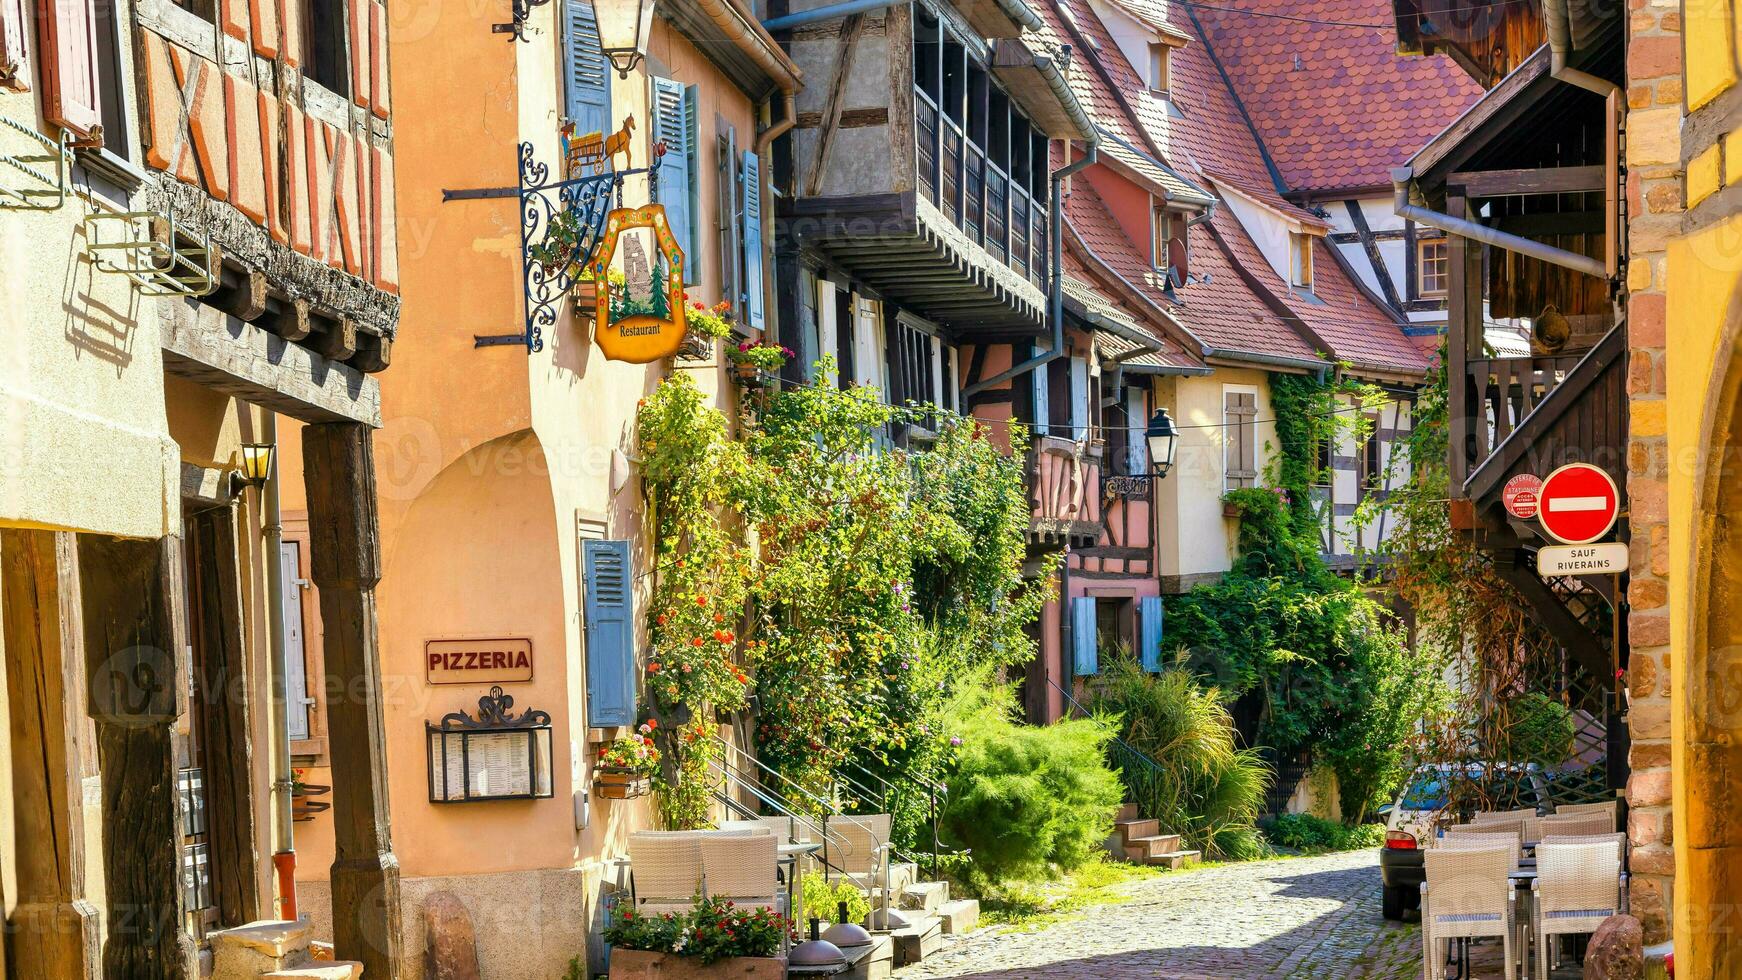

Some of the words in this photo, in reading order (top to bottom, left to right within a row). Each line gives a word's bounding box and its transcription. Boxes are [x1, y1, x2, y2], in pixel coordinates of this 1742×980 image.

[620, 324, 661, 337] Restaurant
[1571, 549, 1596, 557] SAUF
[1558, 560, 1610, 570] RIVERAINS
[429, 651, 529, 670] PIZZERIA
